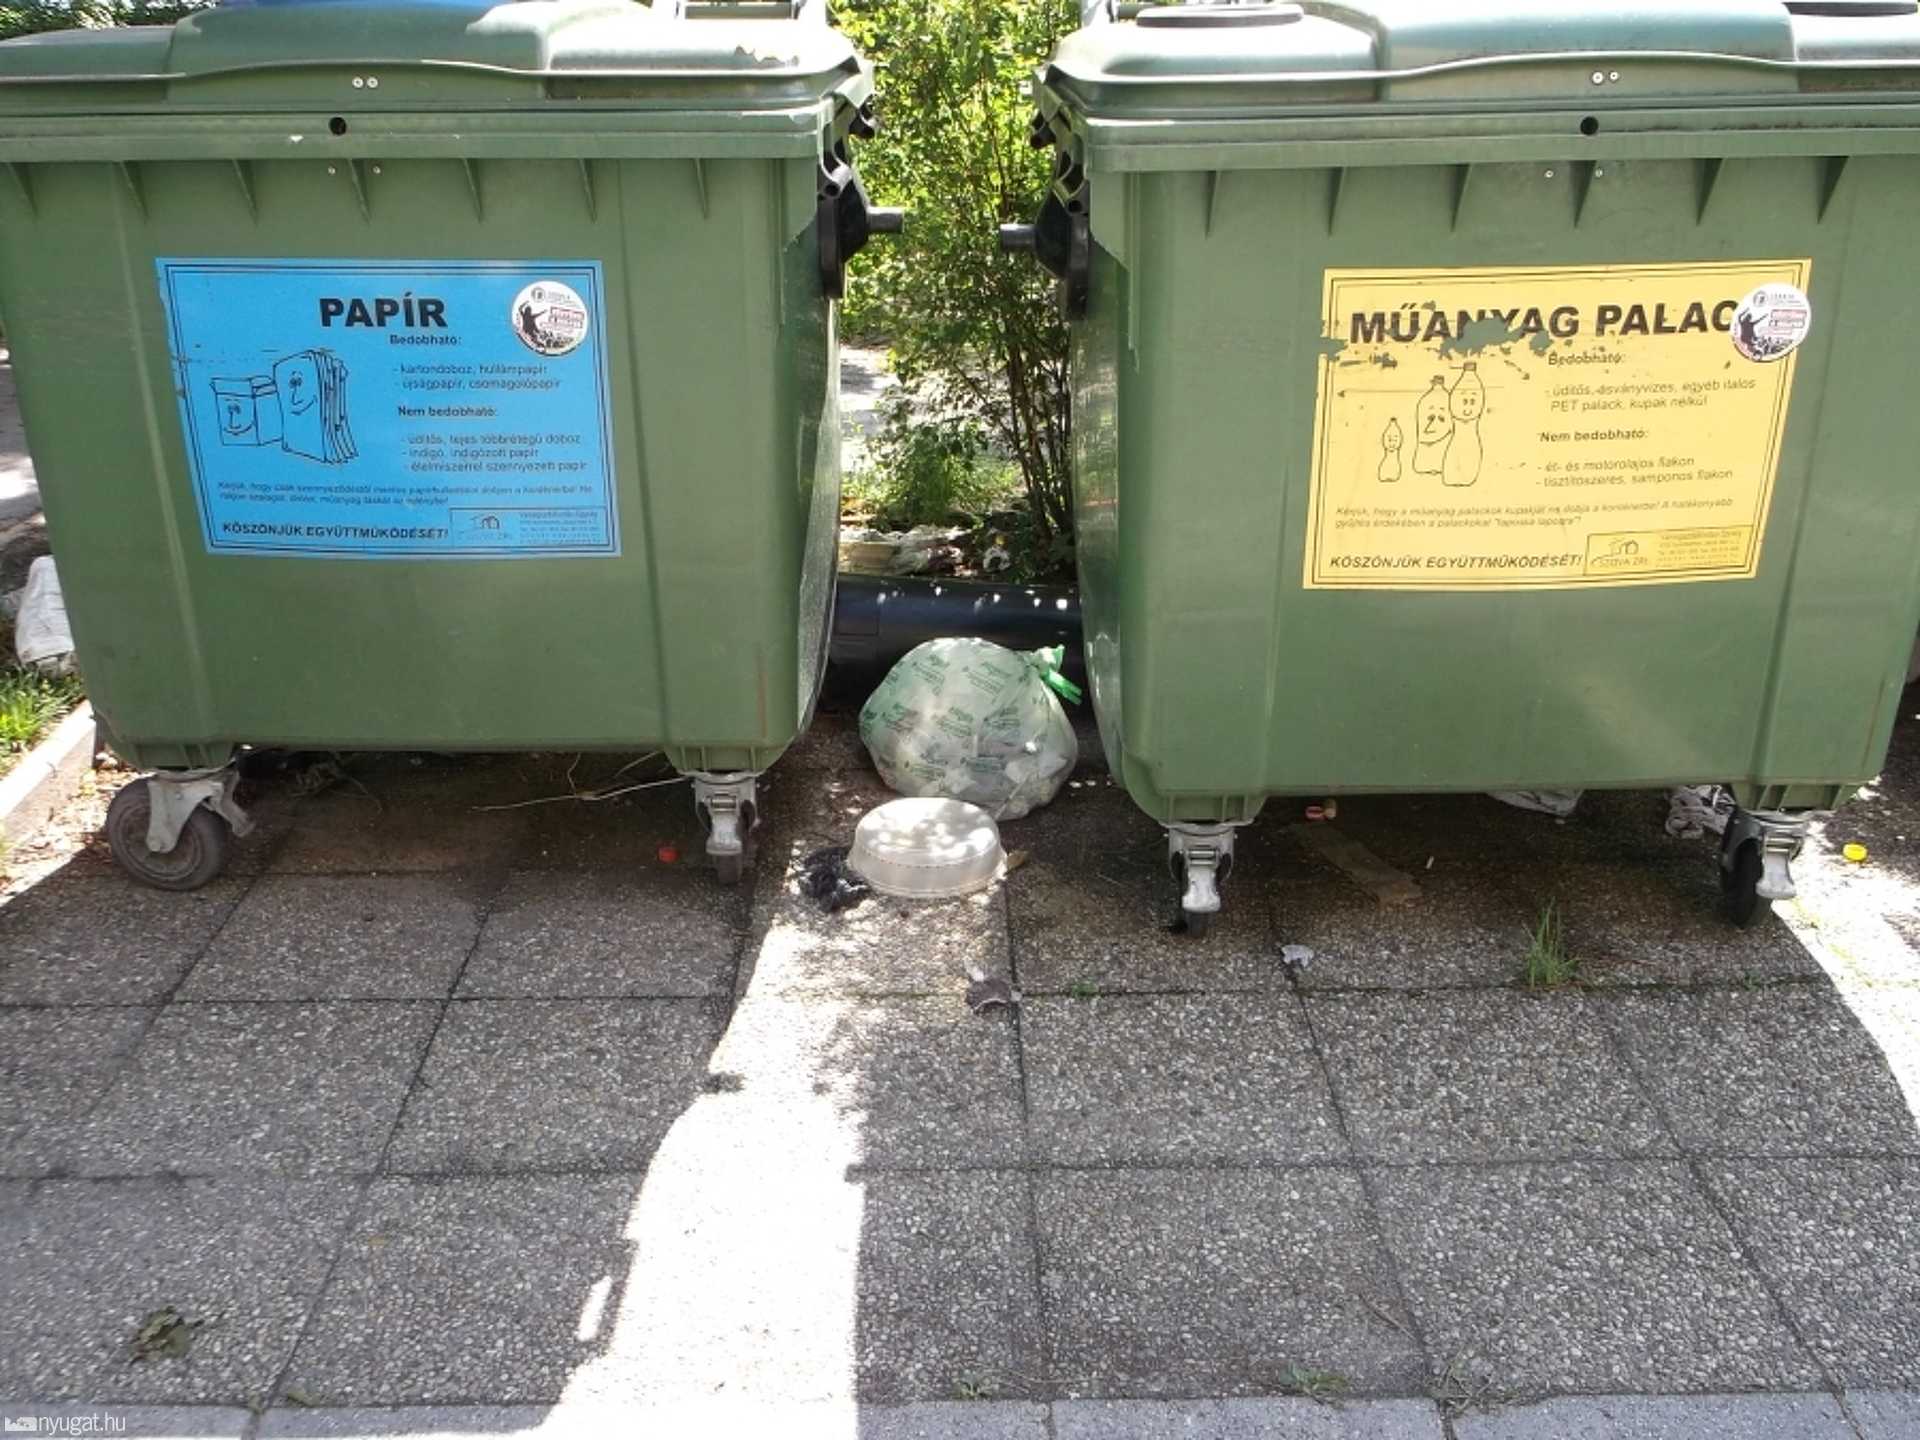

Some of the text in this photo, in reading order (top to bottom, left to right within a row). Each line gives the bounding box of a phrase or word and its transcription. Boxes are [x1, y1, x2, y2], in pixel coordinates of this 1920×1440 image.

[319, 291, 449, 328] PAPÍR
[1595, 300, 1739, 337] PALAC
[390, 334, 462, 345] Bedobható:
[398, 406, 425, 417] Nem
[1550, 400, 1577, 412] PET
[1540, 431, 1571, 443] Nem
